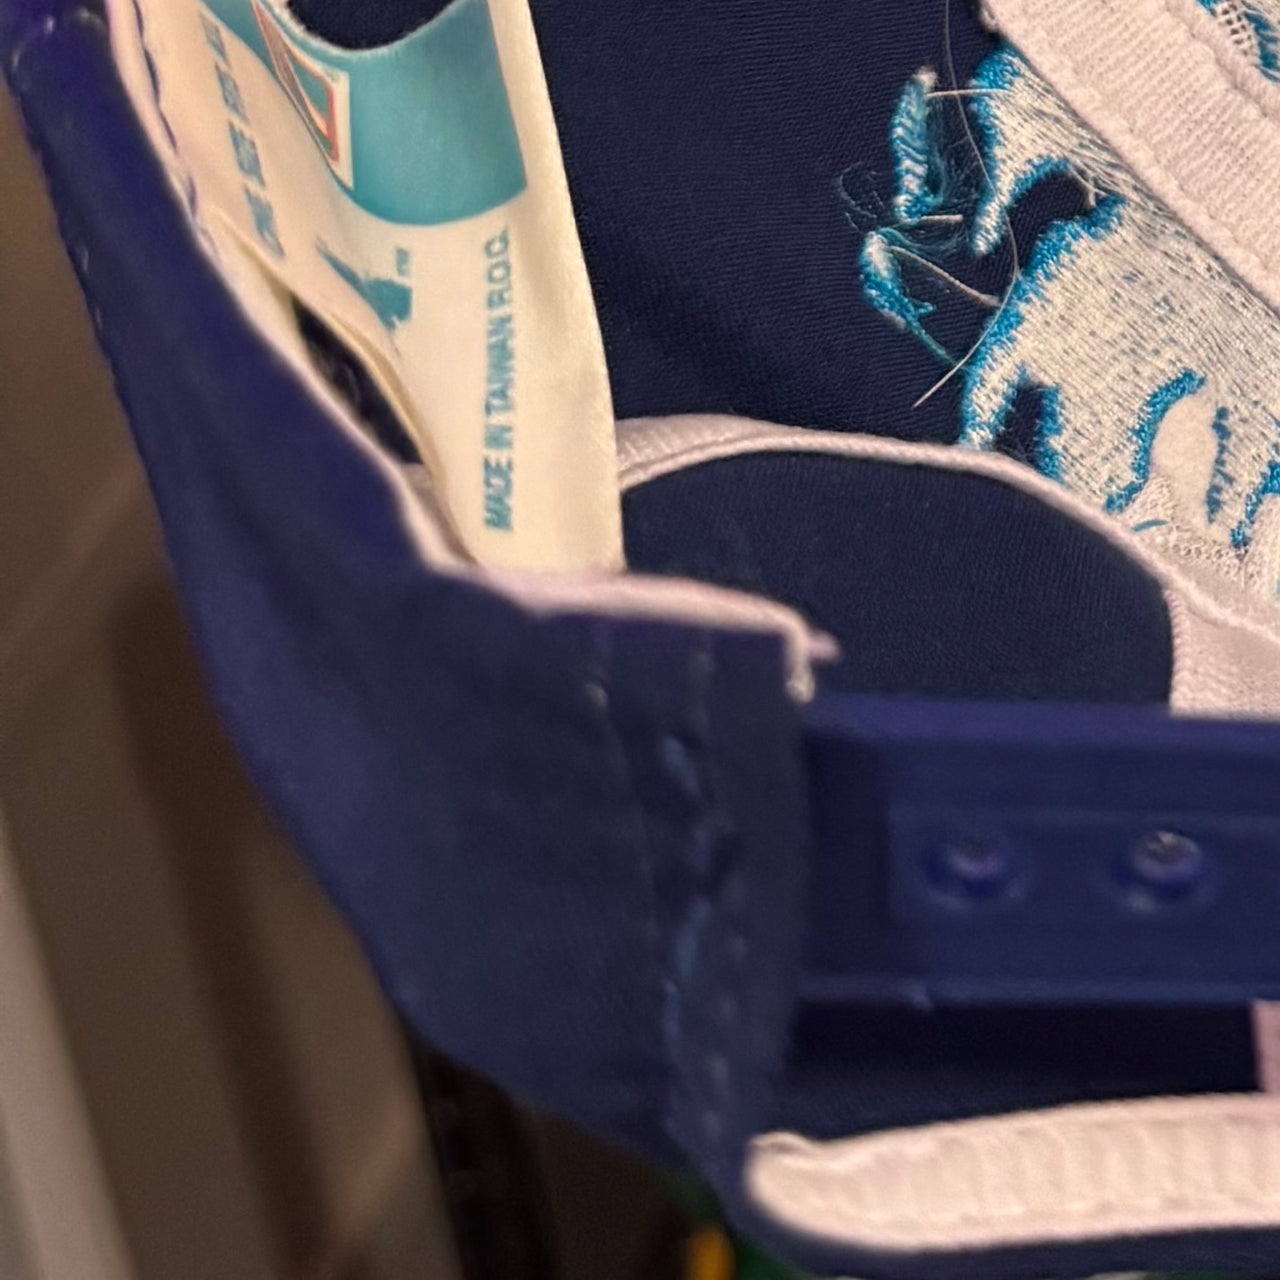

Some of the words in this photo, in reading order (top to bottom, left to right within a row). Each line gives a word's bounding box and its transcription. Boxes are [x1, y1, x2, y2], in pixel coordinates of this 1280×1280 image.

[484, 313, 514, 416] TAIWAN
[483, 423, 514, 449] IN
[484, 456, 513, 530] MADE
